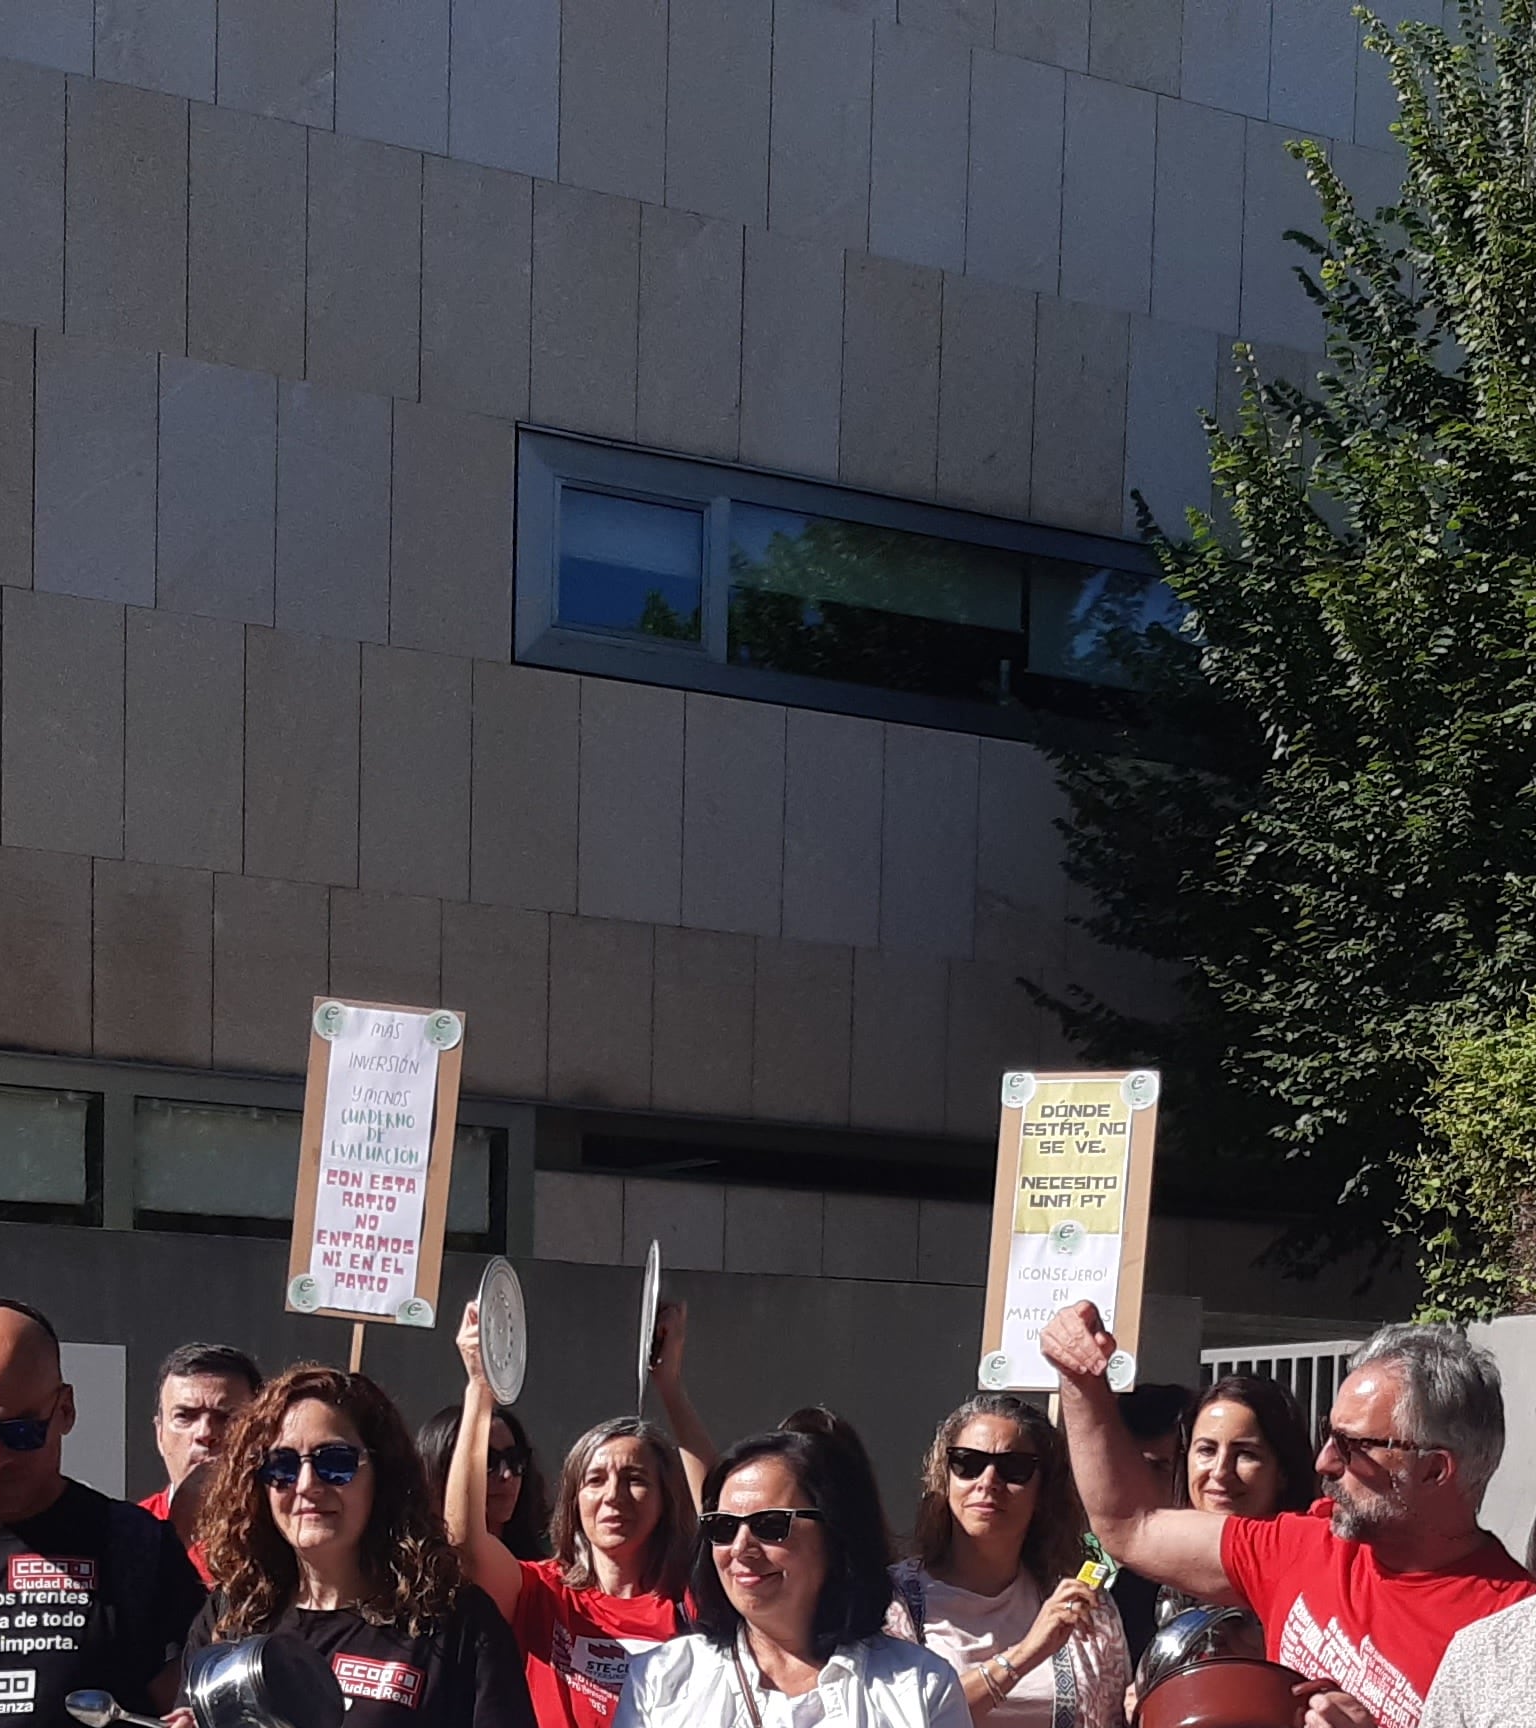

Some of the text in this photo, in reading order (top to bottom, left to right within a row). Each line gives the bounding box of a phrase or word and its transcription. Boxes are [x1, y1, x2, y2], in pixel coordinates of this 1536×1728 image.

[349, 1052, 420, 1075] INVERSIÓN
[1040, 1100, 1110, 1118] DÓNDE
[341, 1108, 415, 1129] CUADERNO
[367, 1126, 385, 1143] DE
[1099, 1122, 1126, 1136] NO
[1039, 1140, 1106, 1154] SE VE.
[326, 1169, 416, 1193] CON ESTA
[1021, 1176, 1117, 1190] NECESITO
[342, 1191, 397, 1212] RATIO
[1029, 1194, 1106, 1208] UNA PT
[355, 1214, 379, 1231] NO
[316, 1229, 414, 1255] ENTRAMOS
[322, 1251, 404, 1275] NI EN EL
[334, 1272, 389, 1293] PATIO
[1053, 1288, 1069, 1301] EN
[13, 1578, 60, 1590] Ciudad
[20, 1590, 93, 1608] frentes,
[14, 1612, 37, 1628] de
[42, 1611, 86, 1628] todo
[0, 1634, 79, 1655] importa.
[339, 1662, 395, 1683] CCOO
[340, 1679, 414, 1708] iudad Real
